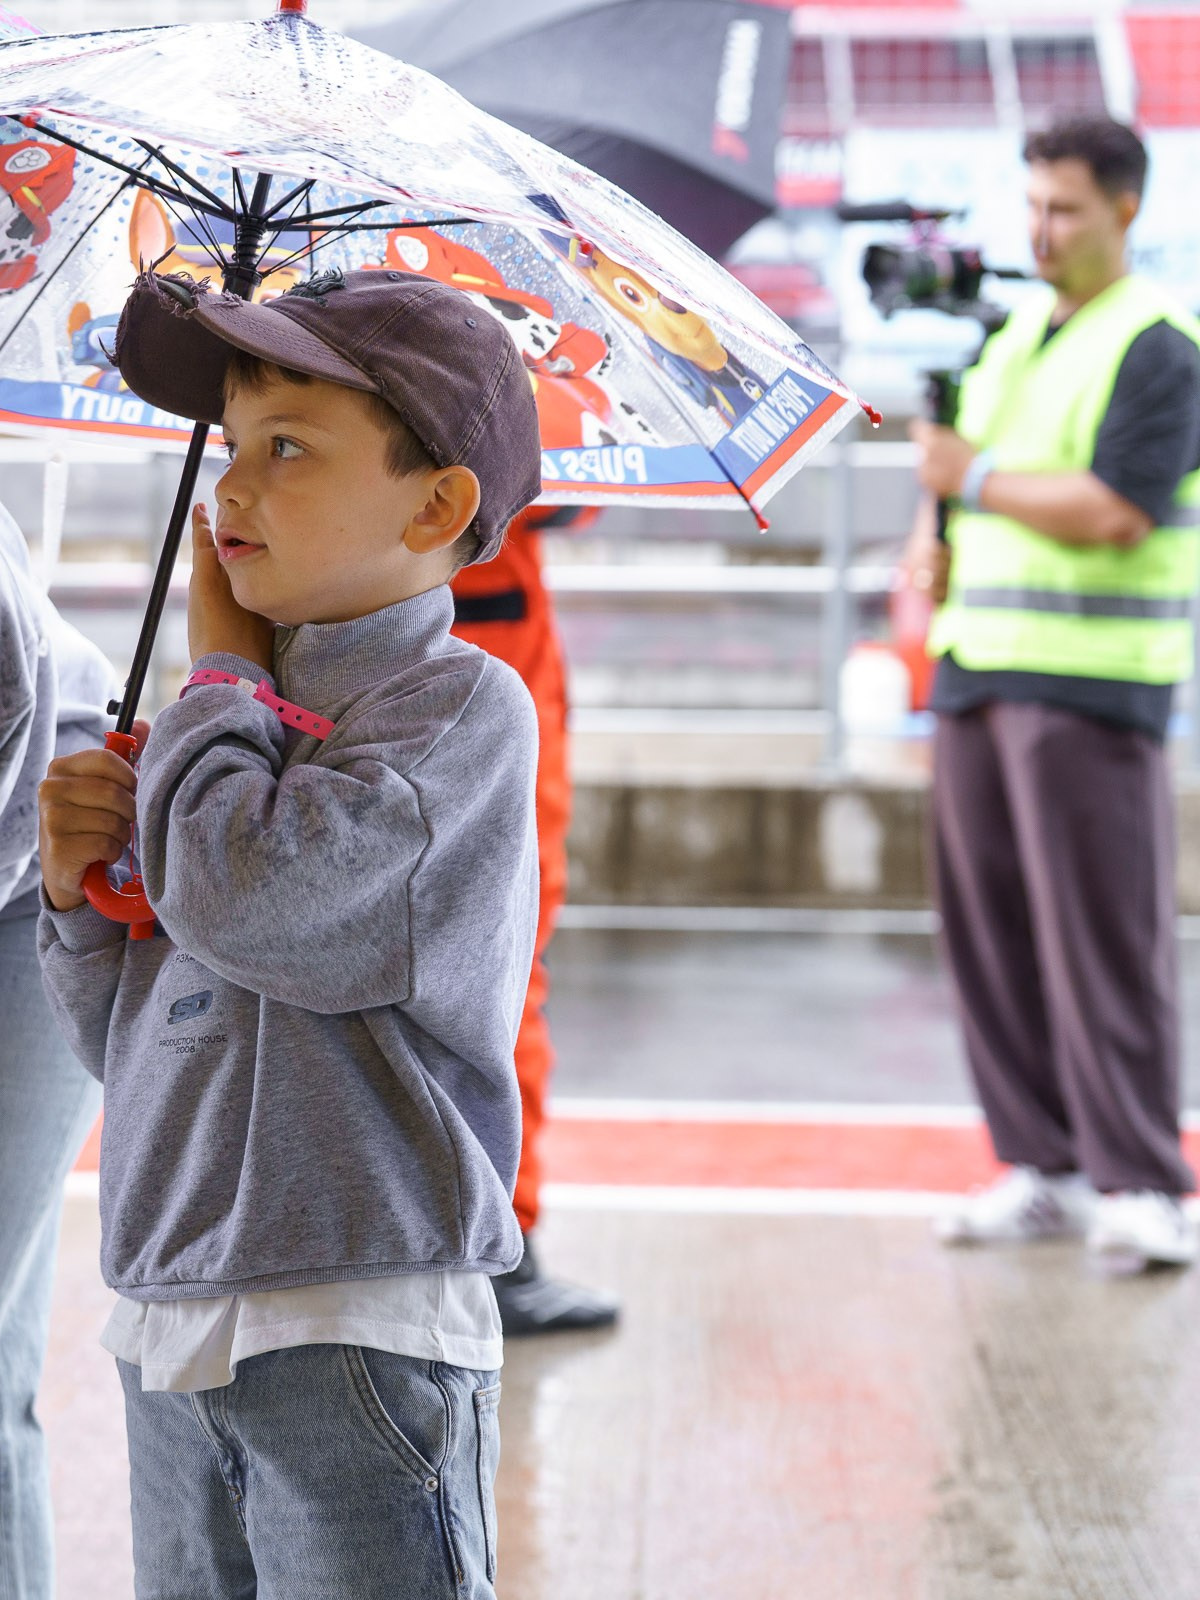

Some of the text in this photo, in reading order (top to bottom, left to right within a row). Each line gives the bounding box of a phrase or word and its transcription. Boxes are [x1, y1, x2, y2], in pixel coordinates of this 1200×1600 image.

[158, 1034, 228, 1048] PRODUCTION HOUSE
[175, 1045, 196, 1054] 2008
